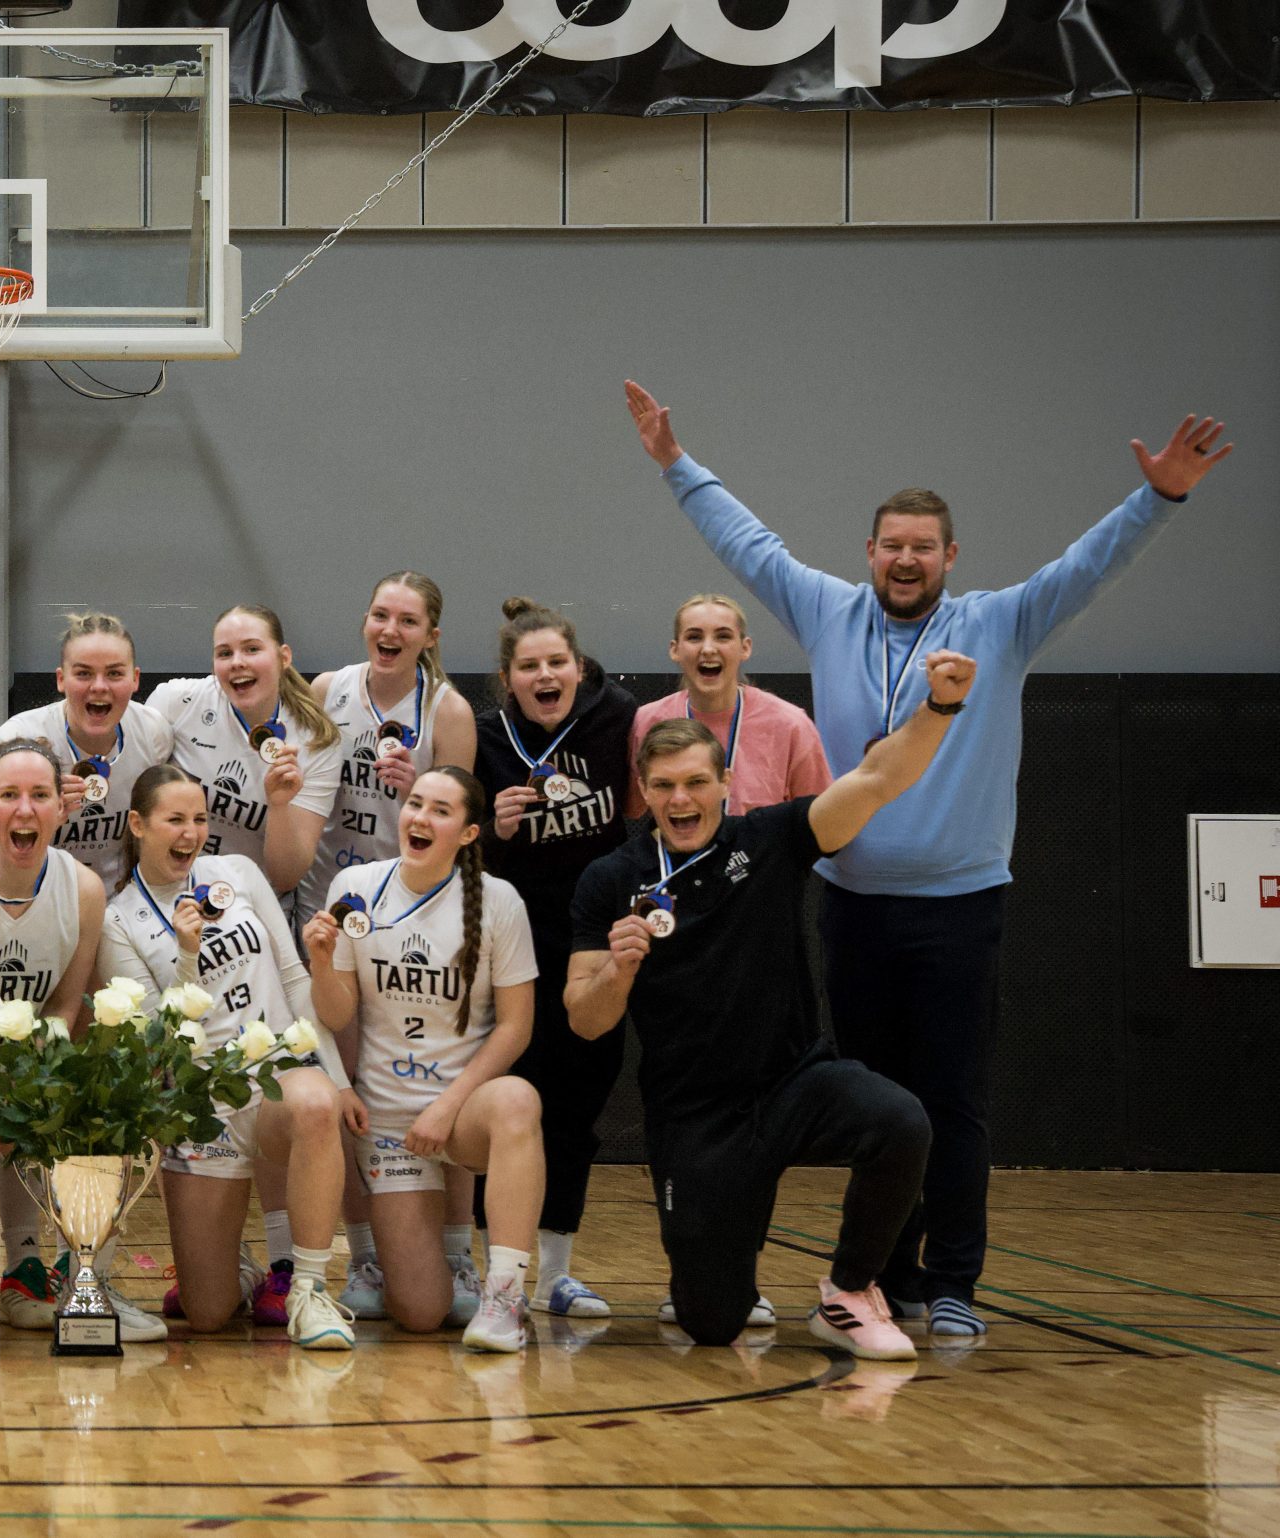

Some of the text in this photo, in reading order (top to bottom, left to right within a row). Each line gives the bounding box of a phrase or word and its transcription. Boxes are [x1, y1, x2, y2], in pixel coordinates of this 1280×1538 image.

[340, 759, 398, 801] ARTU
[342, 808, 377, 836] 20
[521, 786, 615, 844] TARTU
[197, 920, 261, 978] ARTU
[223, 982, 252, 1013] 13
[371, 958, 461, 1001] TARTU
[404, 1017, 424, 1039] 2
[385, 1168, 422, 1177] Stebby
